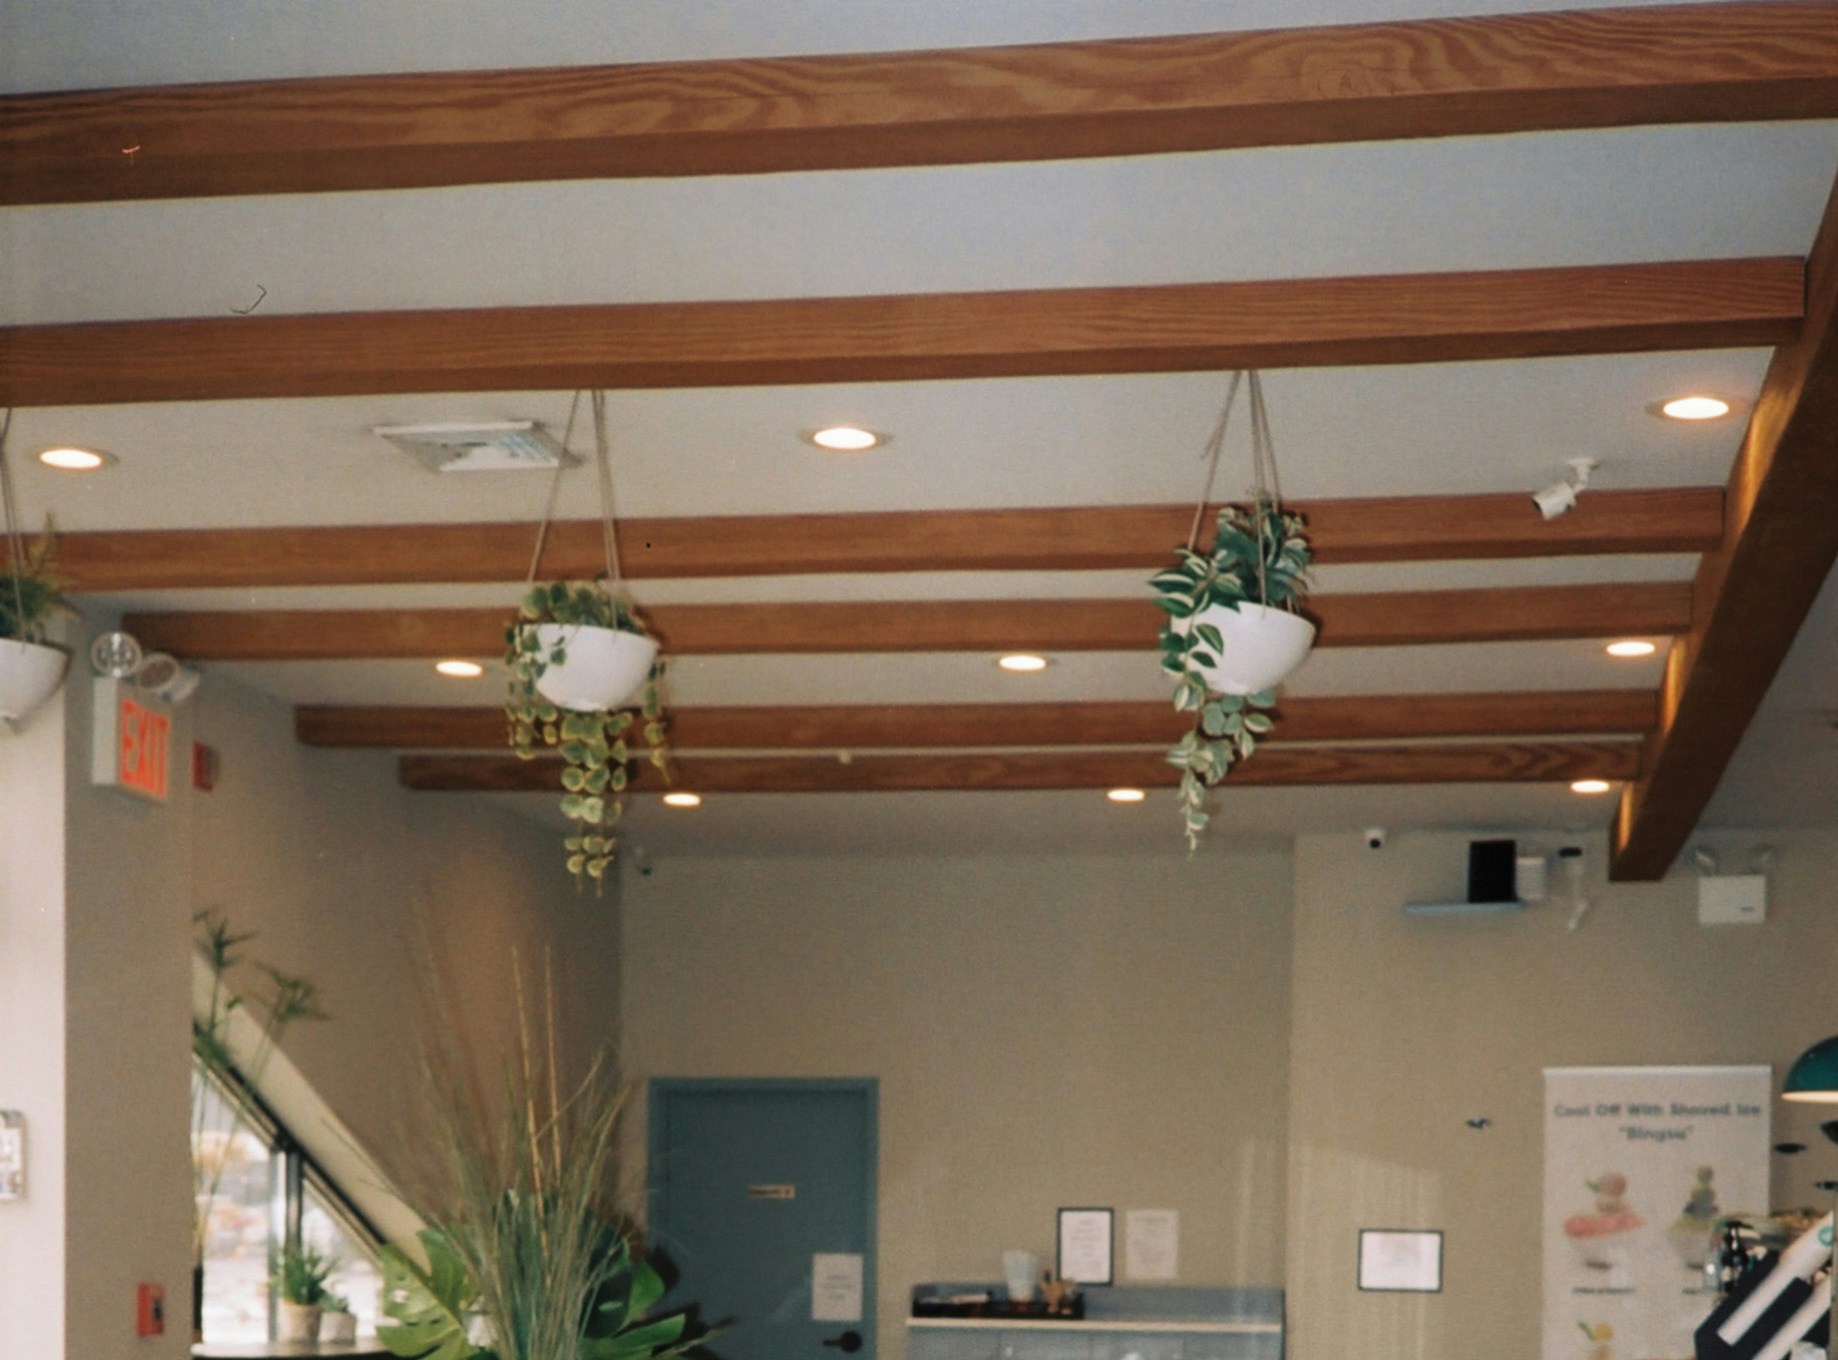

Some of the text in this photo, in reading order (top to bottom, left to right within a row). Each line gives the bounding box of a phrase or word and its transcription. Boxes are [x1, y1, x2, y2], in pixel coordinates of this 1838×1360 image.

[121, 699, 170, 797] EXIT
[1595, 1103, 1621, 1116] Off
[1627, 1103, 1662, 1116] With
